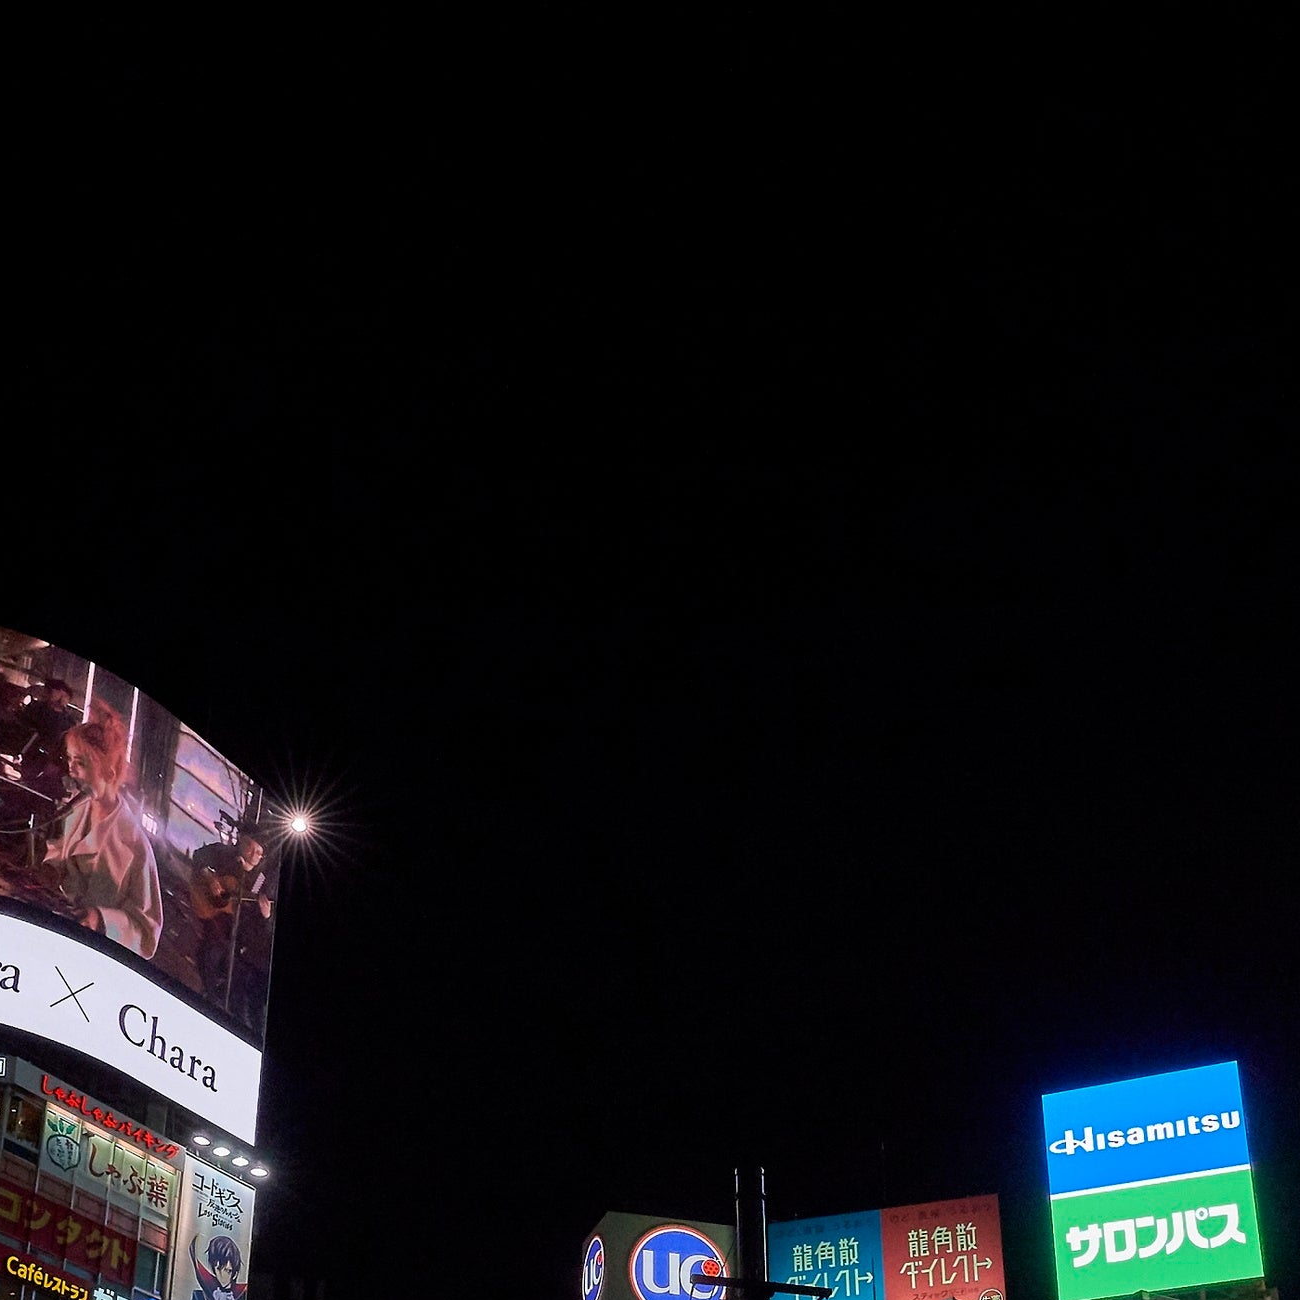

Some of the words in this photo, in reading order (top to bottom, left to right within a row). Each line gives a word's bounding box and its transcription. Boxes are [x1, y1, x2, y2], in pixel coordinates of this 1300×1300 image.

[118, 1004, 219, 1093] Chara
[41, 1075, 180, 1160] しゃぶしゃぶバイキング
[1049, 1110, 1241, 1156] Hisamitsu
[88, 1142, 170, 1210] しゃぶ葉
[192, 1172, 244, 1214] コードギアス
[793, 1237, 860, 1272] 龍角散
[908, 1222, 978, 1258] 龍角散
[1066, 1203, 1246, 1268] サロンパス
[643, 1250, 718, 1300] UC
[900, 1253, 993, 1289] ダイレクト
